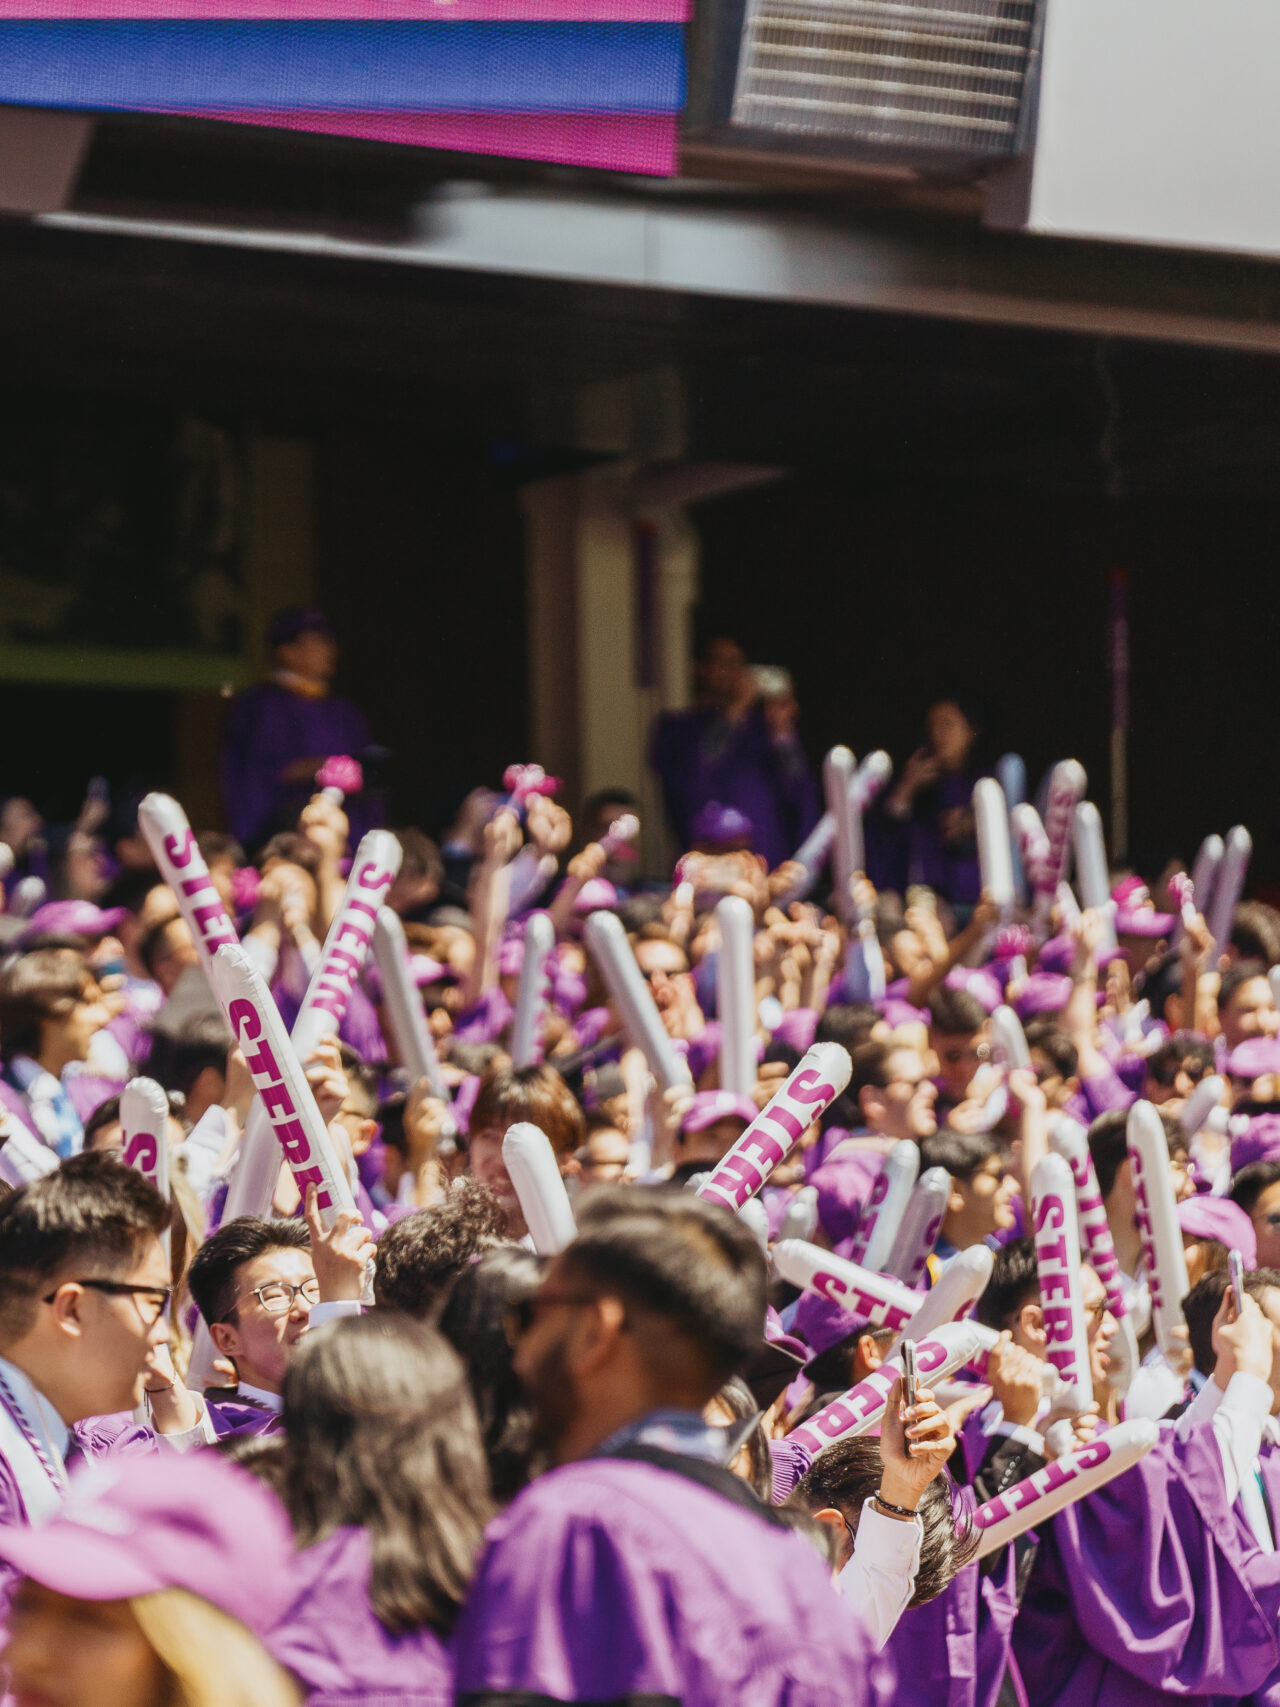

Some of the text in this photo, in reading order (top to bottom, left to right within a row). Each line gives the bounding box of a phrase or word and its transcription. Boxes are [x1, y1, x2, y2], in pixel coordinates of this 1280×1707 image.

[163, 827, 240, 956] STE
[812, 1270, 913, 1332] STE
[1034, 1193, 1078, 1386] STERN
[953, 1440, 1112, 1539] STER
